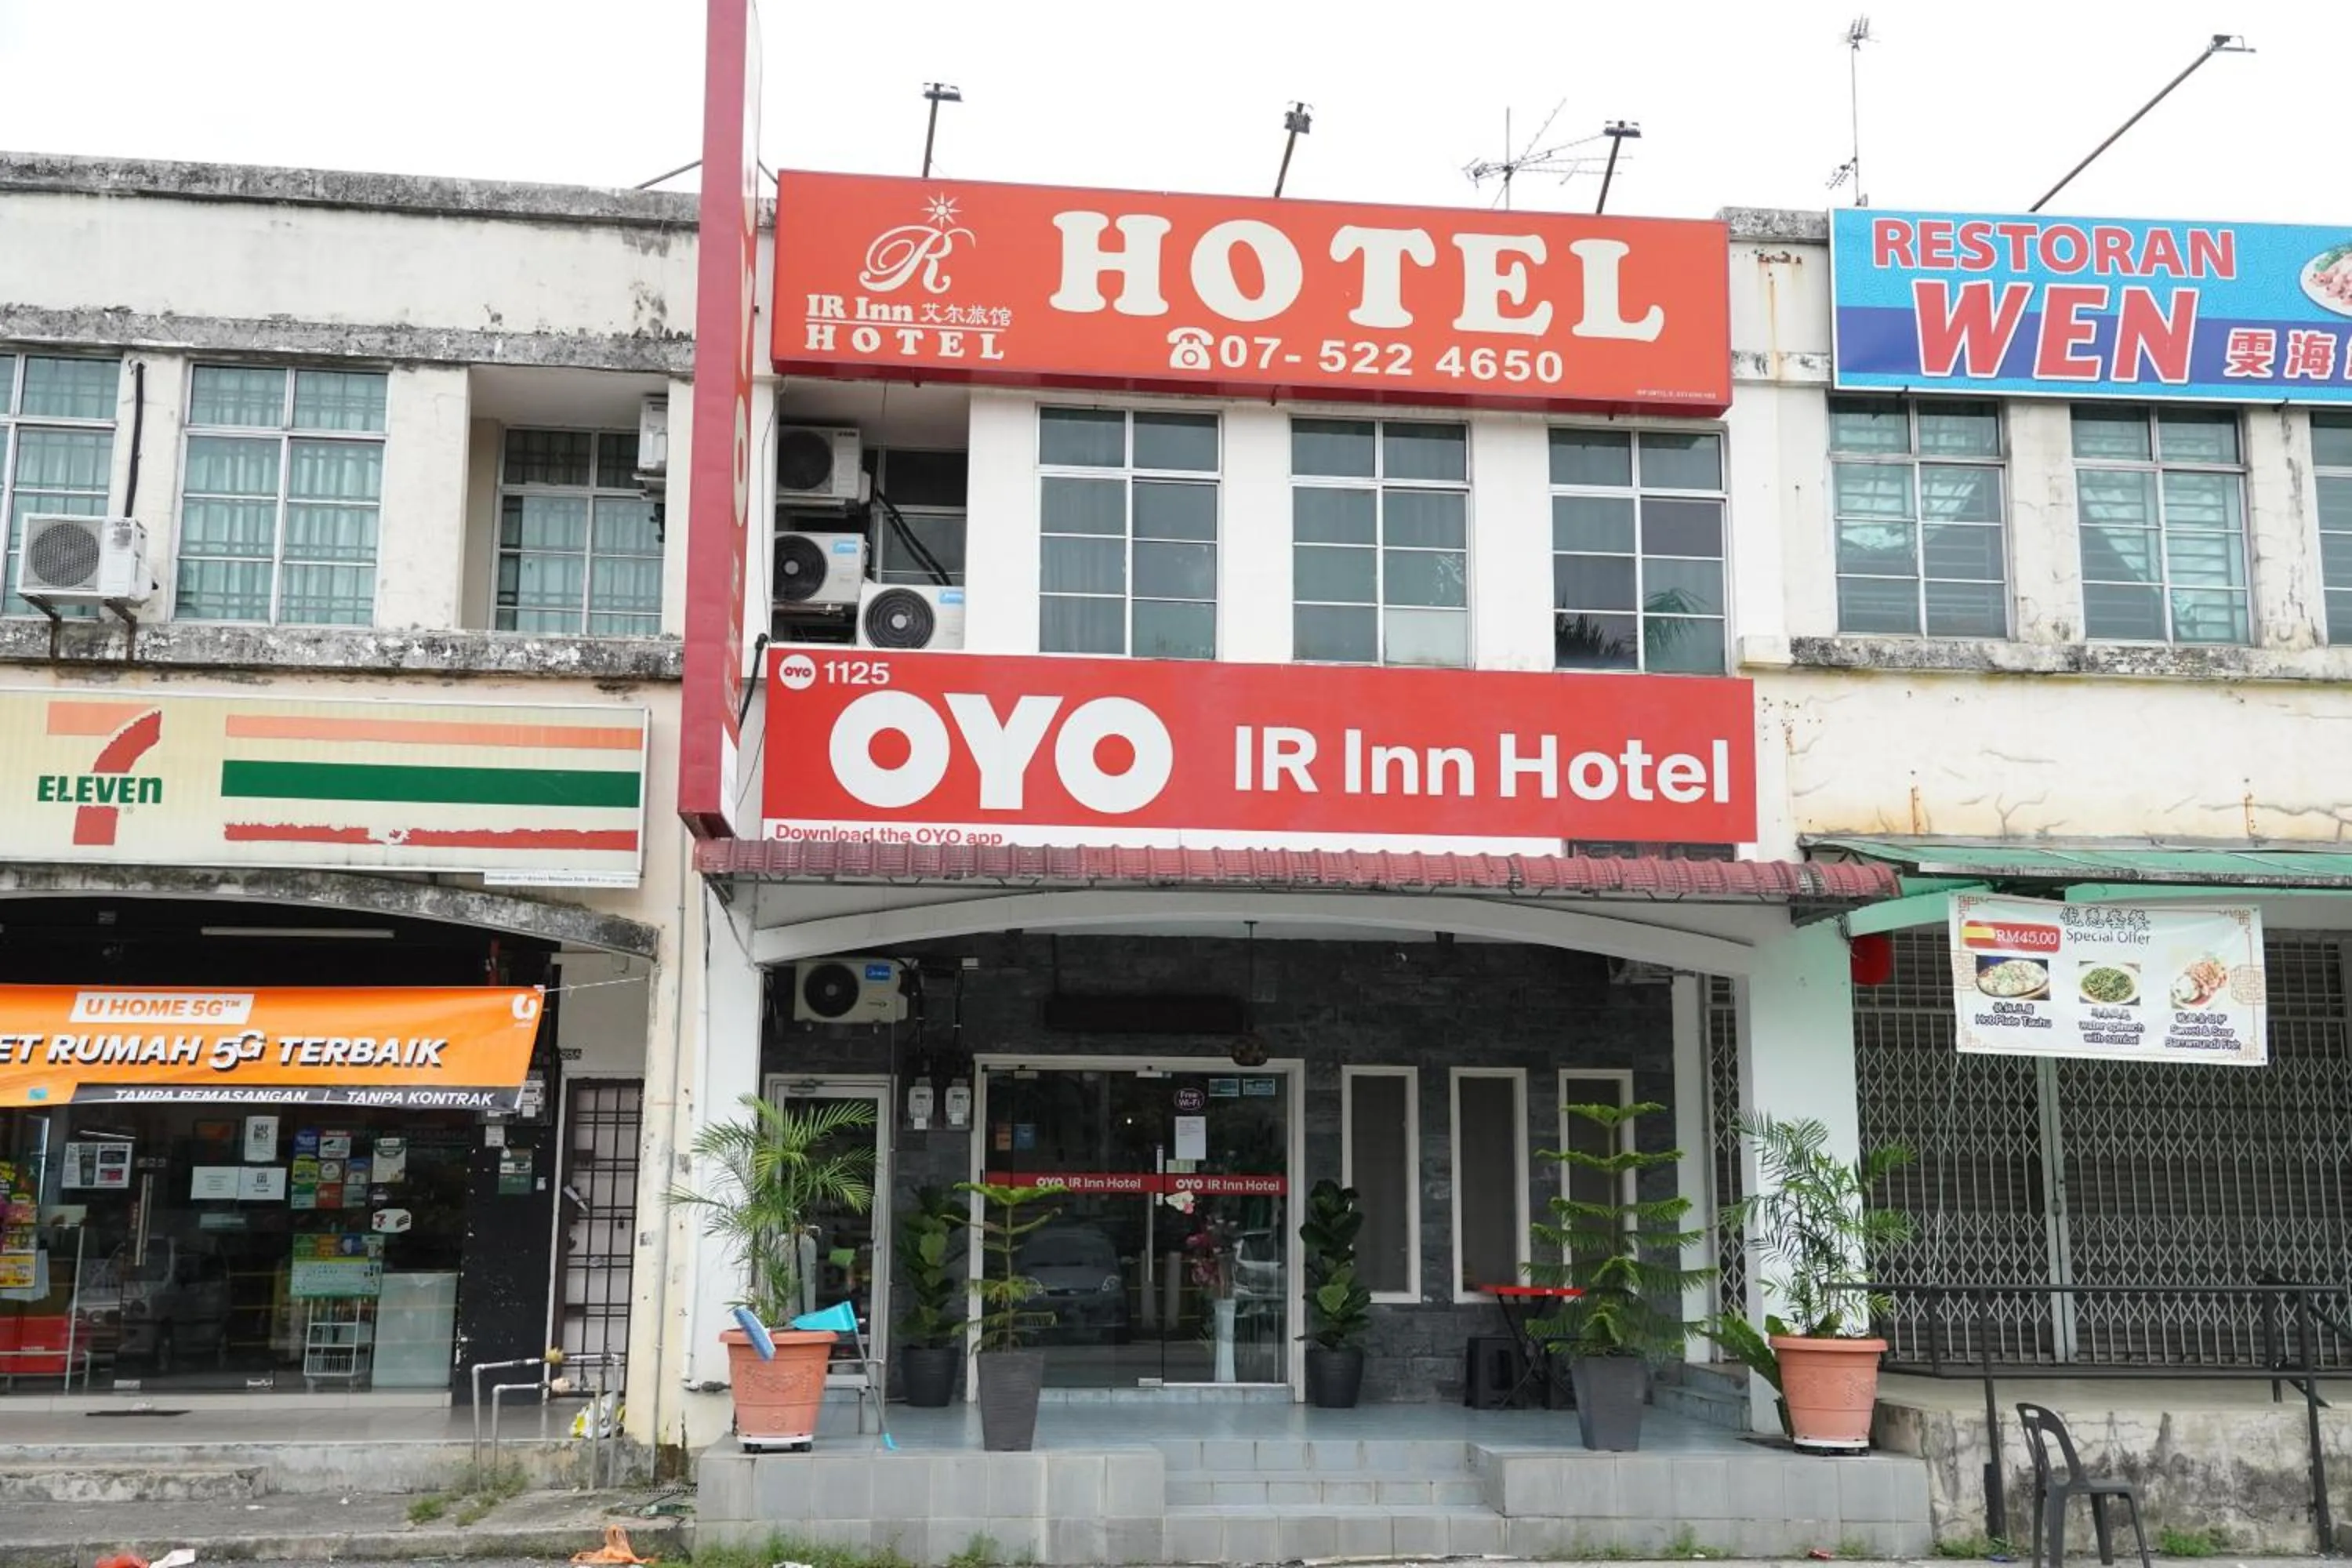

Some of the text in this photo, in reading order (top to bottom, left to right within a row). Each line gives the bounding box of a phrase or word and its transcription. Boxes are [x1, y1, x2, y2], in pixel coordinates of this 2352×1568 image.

[1871, 218, 2237, 280] RESTORAN
[1049, 210, 1664, 342] HOTEL
[807, 294, 914, 322] IR Inn
[920, 303, 1012, 326] 艾尔旅馆
[804, 324, 1005, 360] HOTEL
[1911, 279, 2200, 383] WEN
[1319, 339, 1413, 376] 522
[1435, 347, 1563, 383] 4650
[2223, 327, 2352, 380] 雯海
[784, 662, 891, 684] OYO 1125
[829, 690, 1729, 814] OYO IR Inn Hotel
[775, 825, 1003, 846] Download the OYO app
[1995, 929, 2058, 946] RM45.00
[2066, 929, 2151, 945] Special Offer
[85, 999, 103, 1015] U
[107, 999, 188, 1016] HOME
[46, 1034, 202, 1065] RUMAH
[209, 1029, 267, 1071] 5G
[278, 1038, 448, 1068] TERBAIK
[347, 1091, 403, 1105] TANPA
[407, 1092, 495, 1106] KONTRAK
[1036, 1178, 1142, 1189] OYO IR Inn Hotel
[1176, 1179, 1279, 1191] OYO IR Inn Hotel
